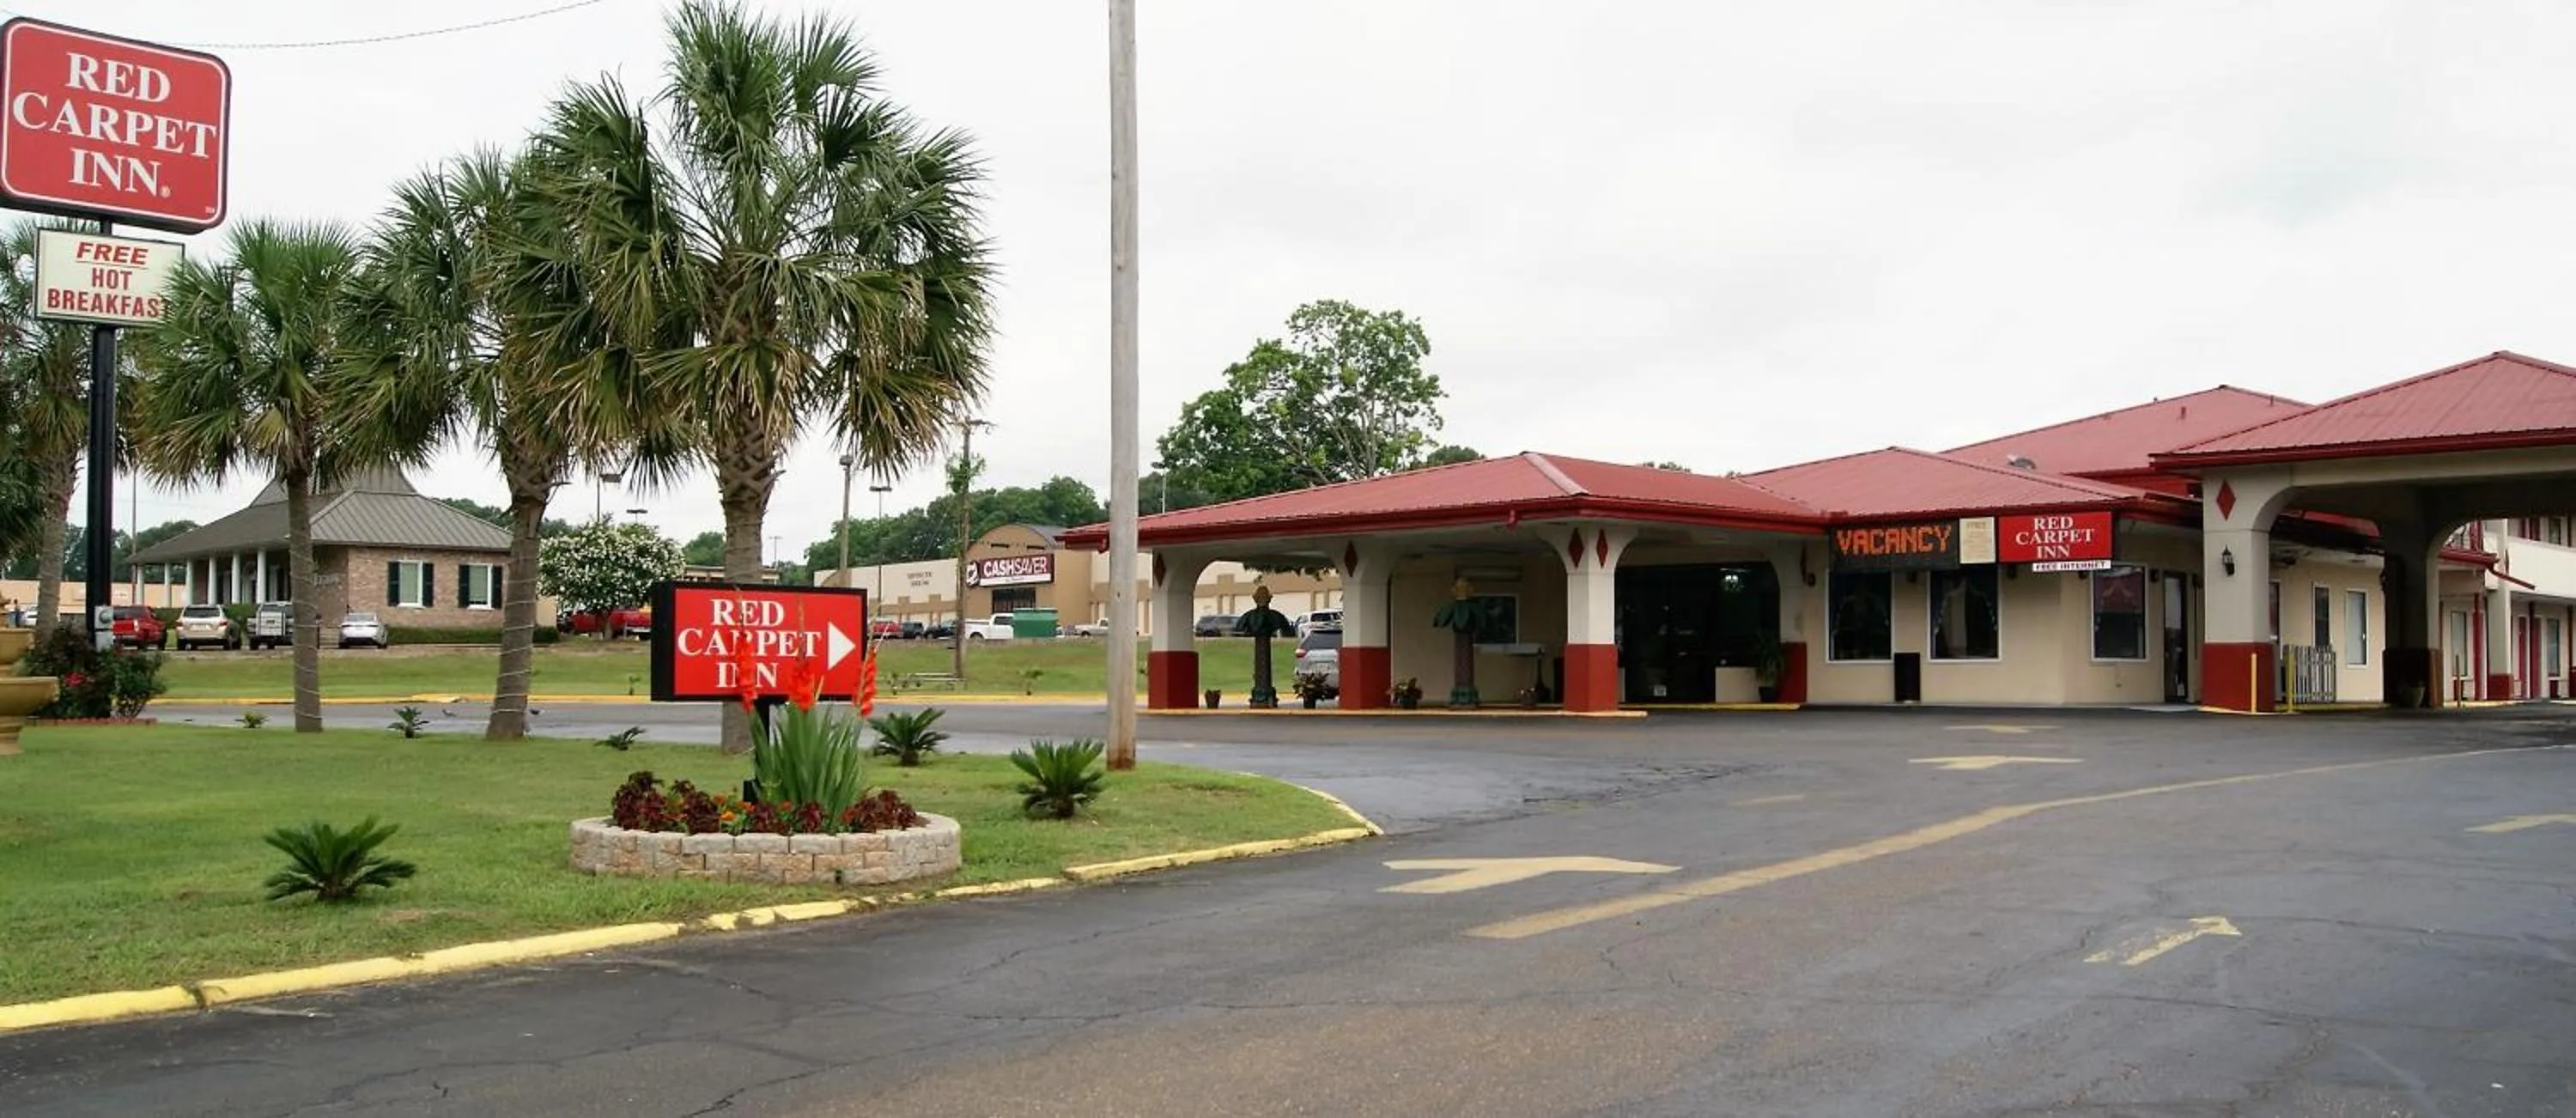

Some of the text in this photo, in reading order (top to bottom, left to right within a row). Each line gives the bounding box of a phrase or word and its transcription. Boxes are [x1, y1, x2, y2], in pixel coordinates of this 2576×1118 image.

[66, 52, 171, 103] RED
[13, 92, 216, 158] CARPET
[76, 241, 149, 265] FREE
[92, 267, 132, 290] HOT
[47, 288, 165, 318] BREAKFAS
[2034, 516, 2074, 530] RED
[1837, 525, 1952, 556] VACANCY
[2015, 528, 2095, 545] CARPET
[2037, 544, 2071, 559] INN
[711, 598, 785, 627] RED
